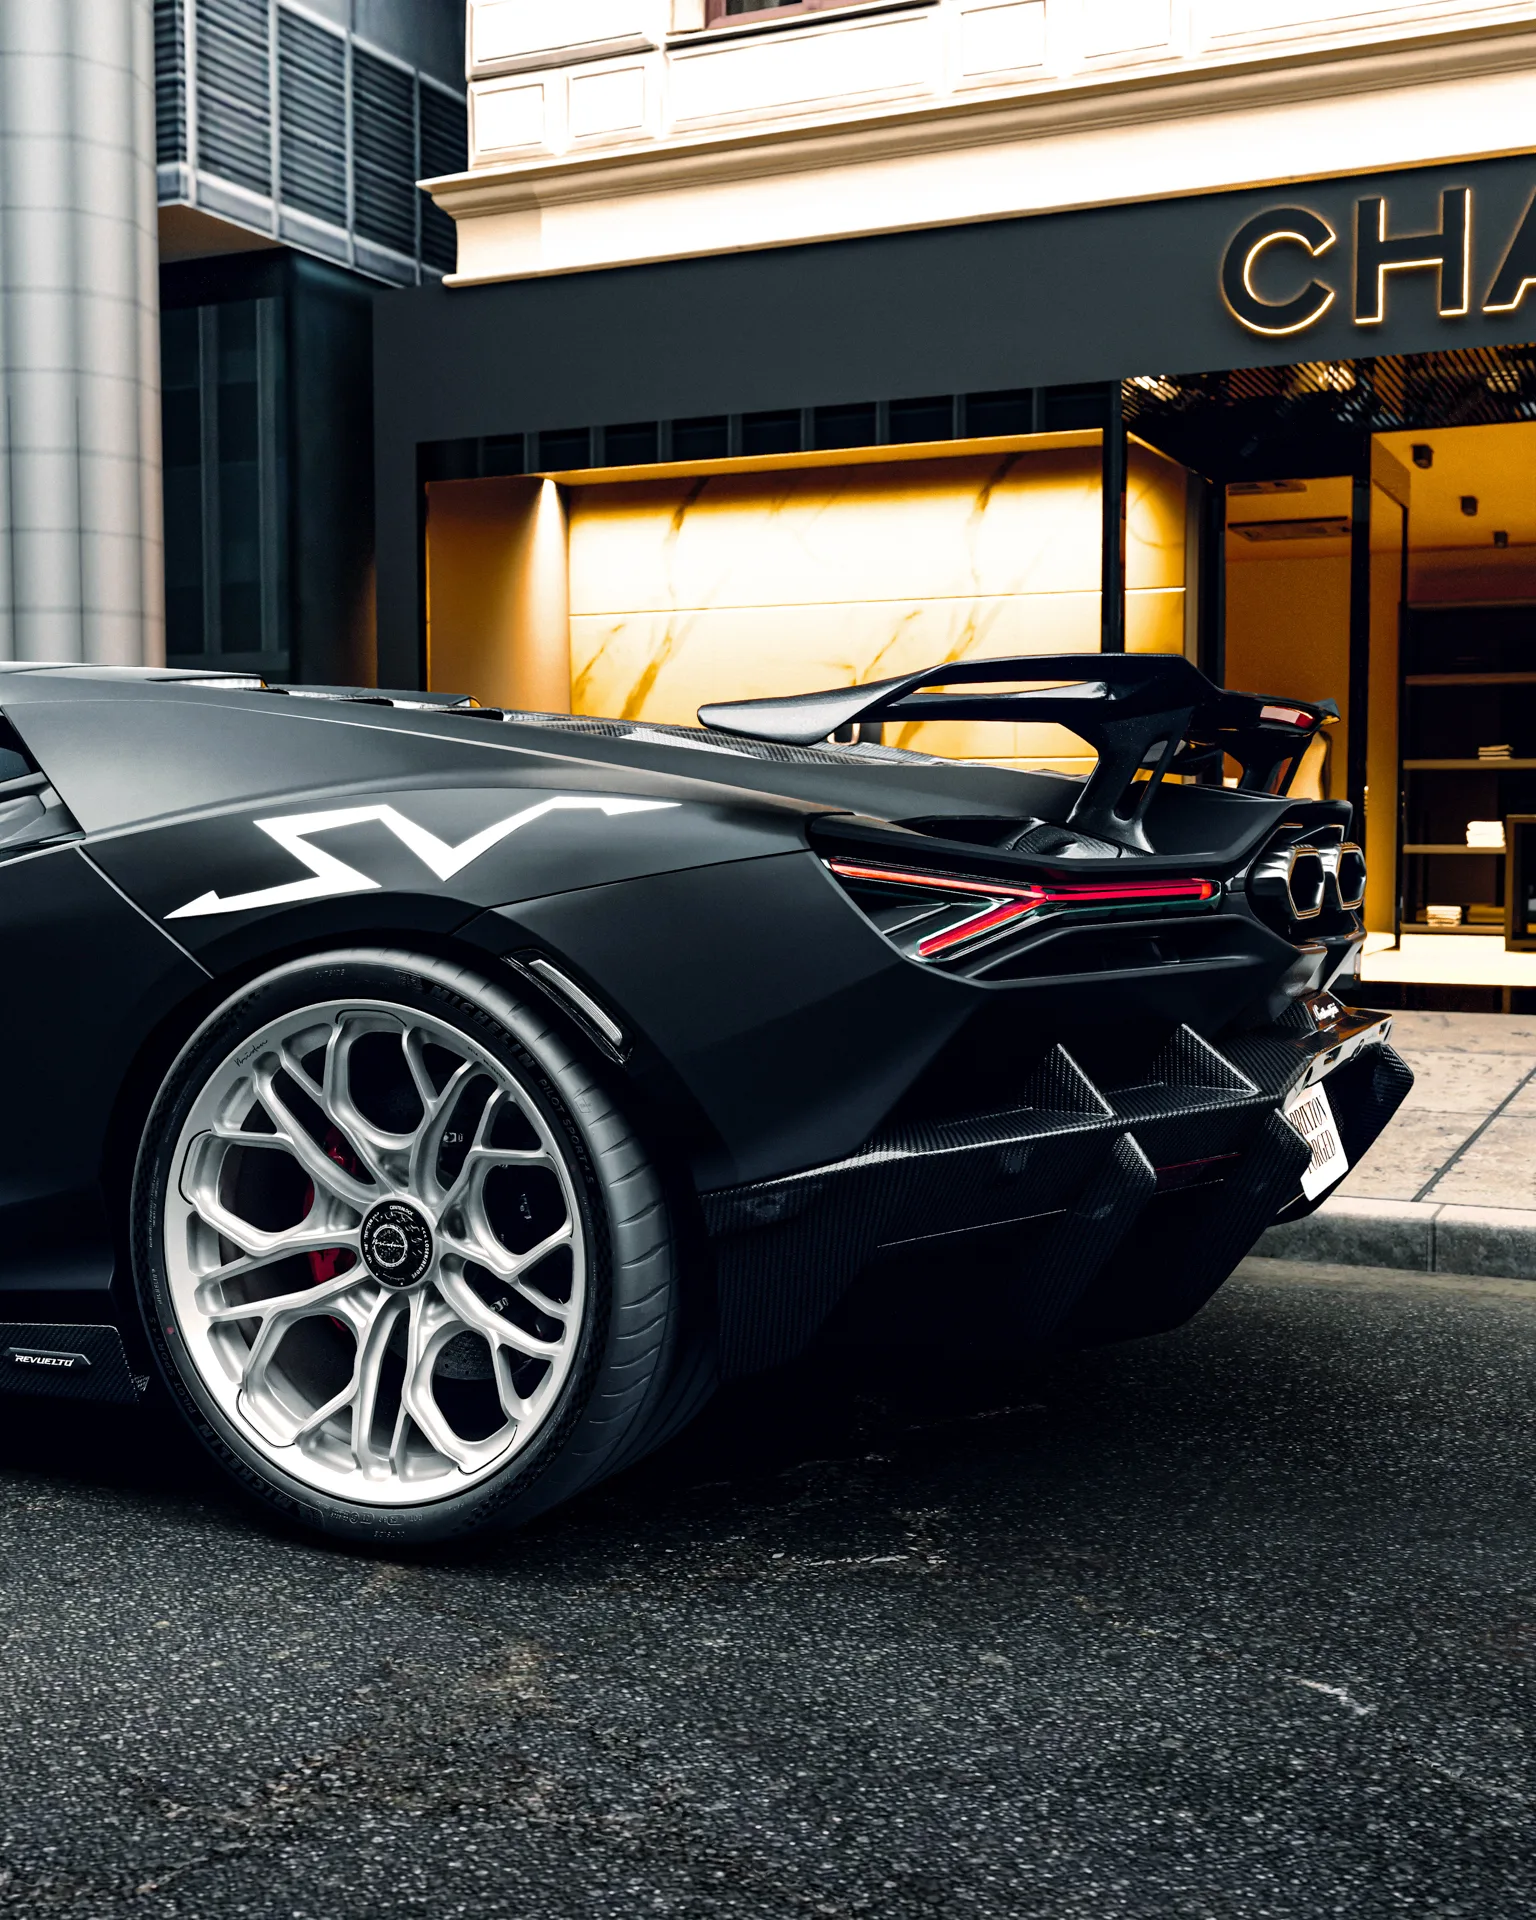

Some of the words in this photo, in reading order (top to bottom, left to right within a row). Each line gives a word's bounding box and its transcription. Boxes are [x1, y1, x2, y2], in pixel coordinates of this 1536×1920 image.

[429, 985, 535, 1068] MICHELIN
[538, 1078, 566, 1115] PILOT
[563, 1118, 587, 1164] SPORT
[1308, 1129, 1336, 1174] ORGED
[15, 1353, 75, 1367] REVUELTO
[174, 1382, 197, 1415] PILOT
[199, 1424, 293, 1509] MICHELIN
